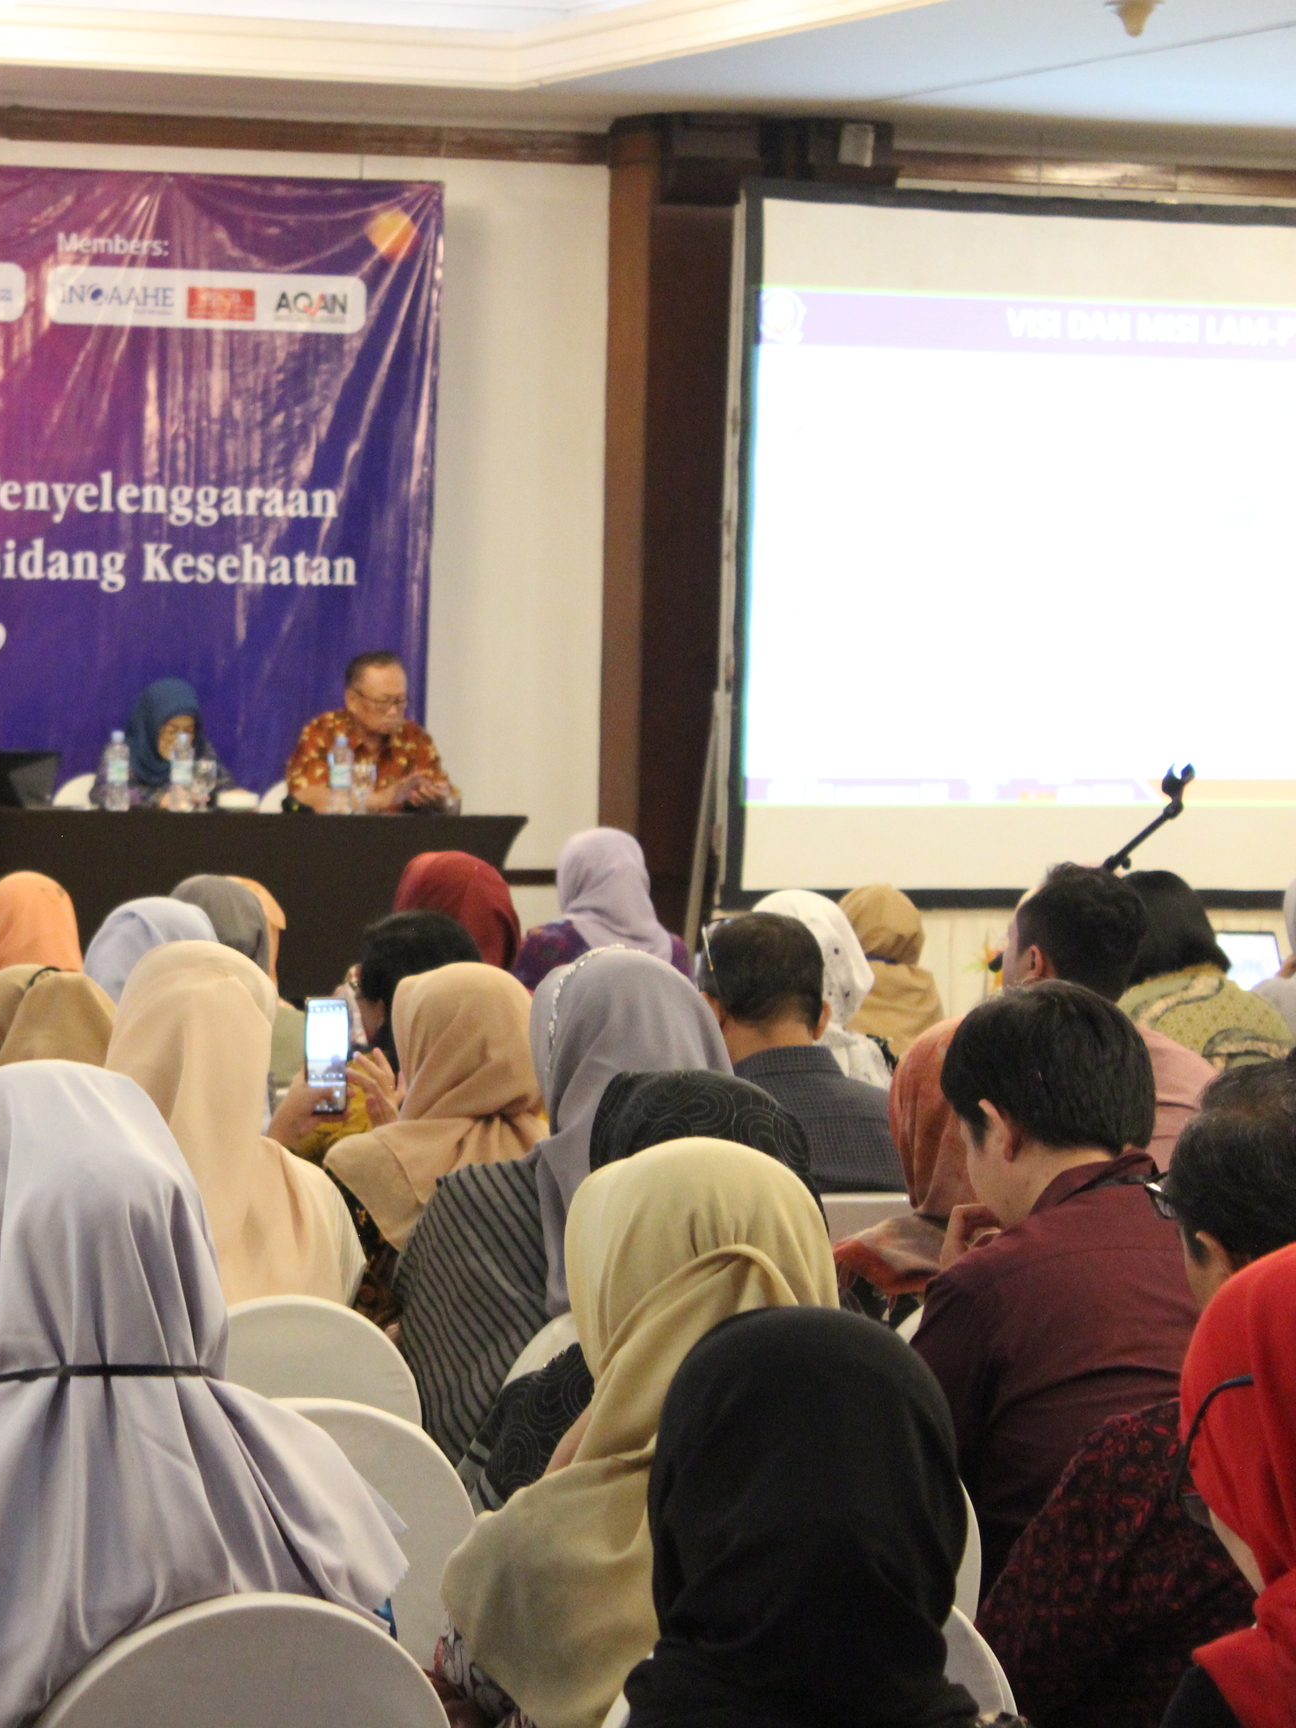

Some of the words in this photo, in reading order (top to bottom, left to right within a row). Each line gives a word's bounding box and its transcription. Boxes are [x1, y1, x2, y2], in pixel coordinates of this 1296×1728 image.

[57, 232, 169, 256] Members:
[1006, 307, 1061, 339] VISI
[1068, 310, 1131, 341] DAN
[1137, 312, 1199, 343] MISI
[143, 542, 356, 586] Kesehatan
